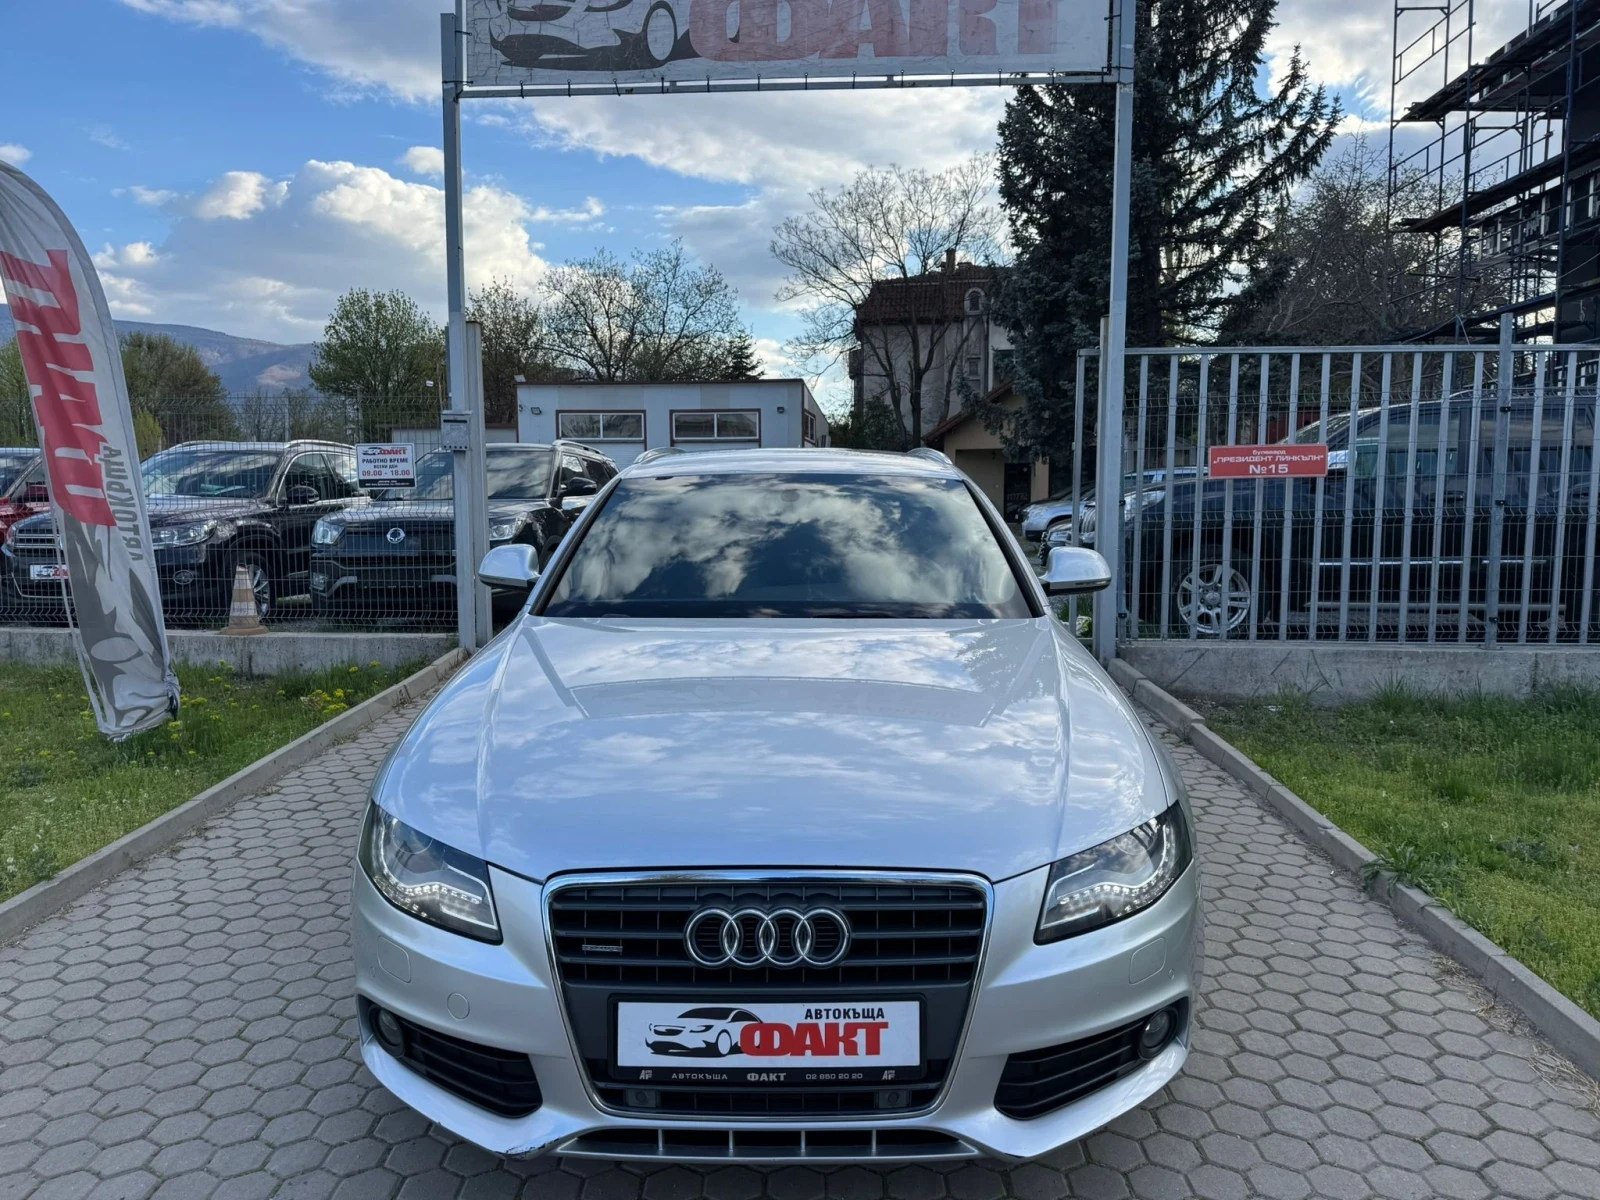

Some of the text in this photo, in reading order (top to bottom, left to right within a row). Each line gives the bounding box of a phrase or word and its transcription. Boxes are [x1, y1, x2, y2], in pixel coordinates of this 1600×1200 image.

[804, 1007, 885, 1021] АВТОКЪЩА
[739, 1021, 889, 1057] ФАКТ
[746, 1072, 787, 1081] ФАКТ
[851, 1072, 863, 1080] 20
